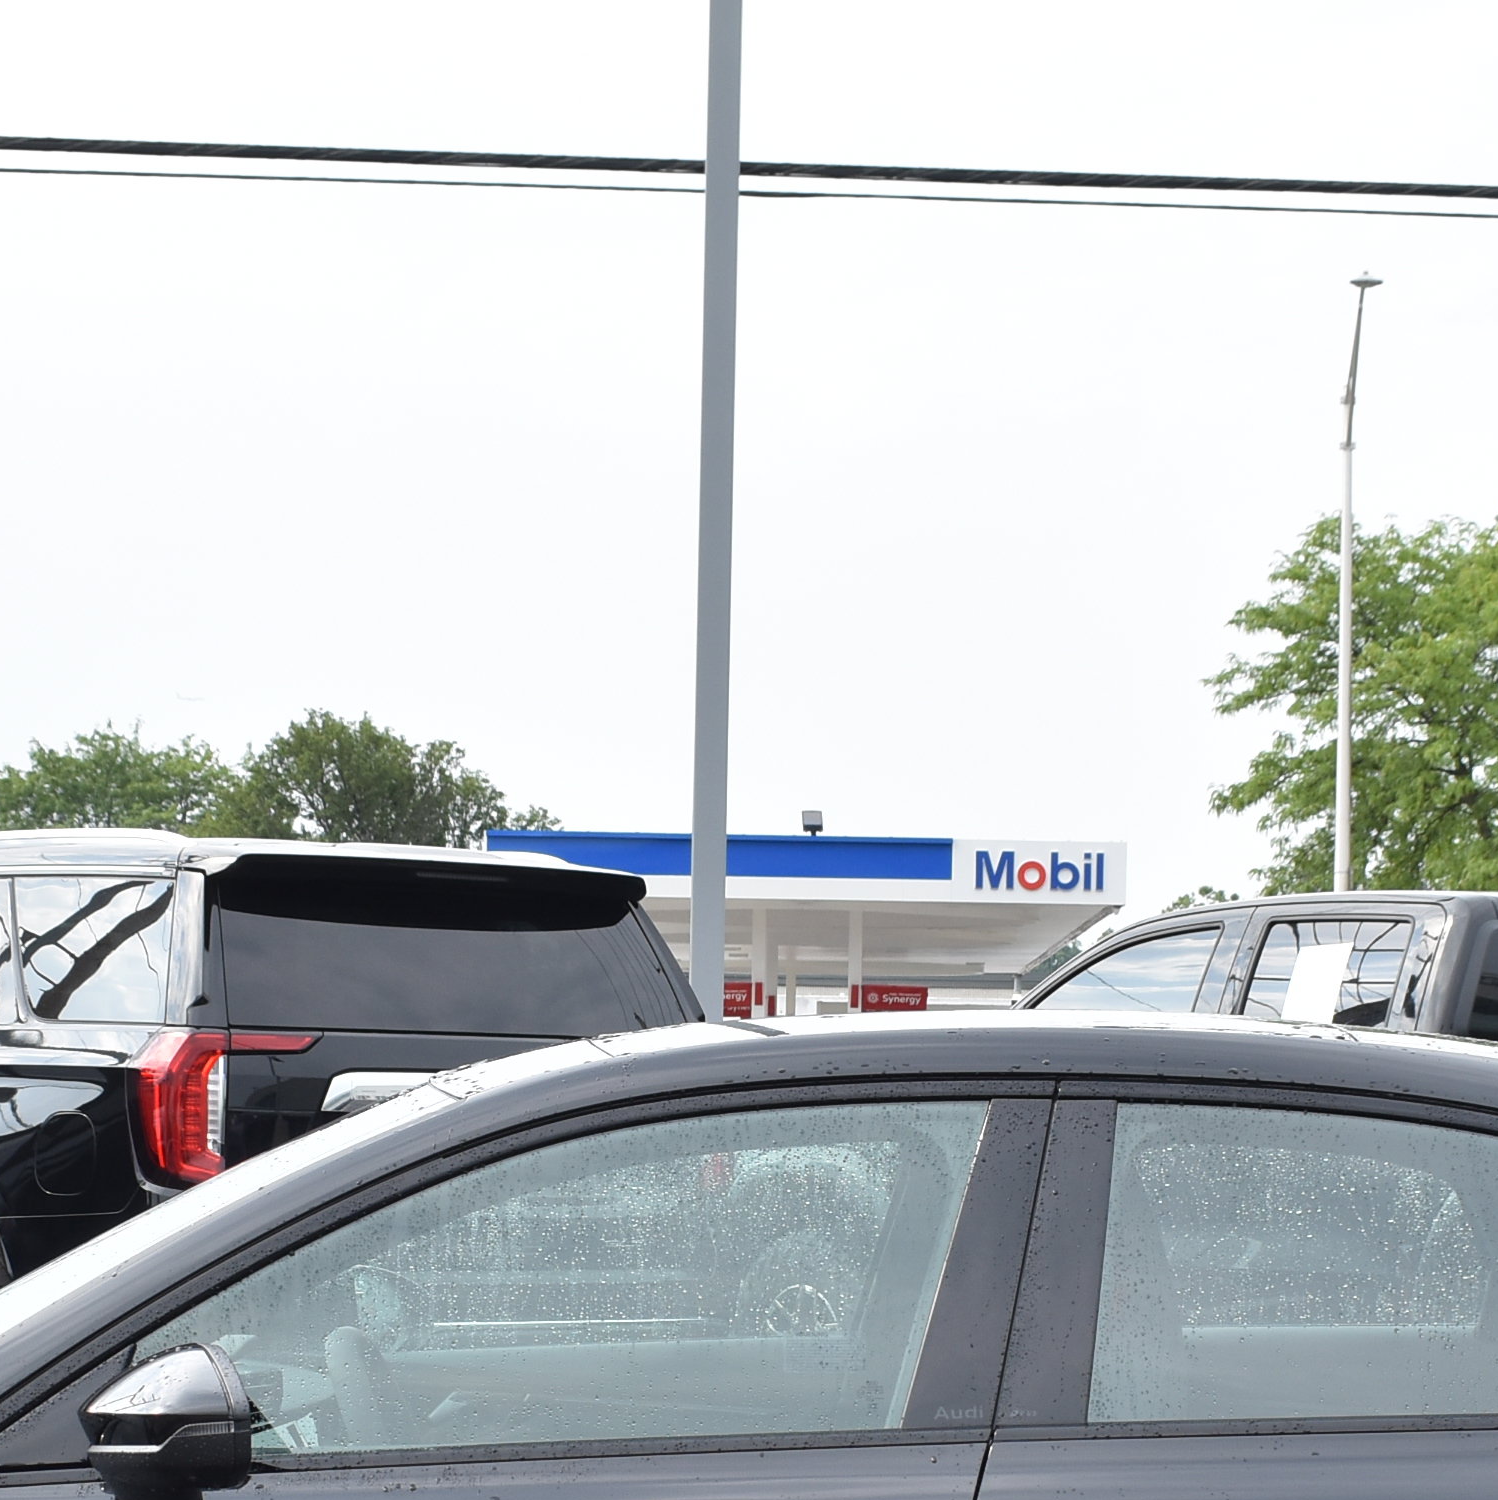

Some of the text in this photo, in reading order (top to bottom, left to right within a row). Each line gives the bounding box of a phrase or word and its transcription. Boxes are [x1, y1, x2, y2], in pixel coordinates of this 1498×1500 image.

[975, 850, 1105, 891] Mobil
[882, 993, 922, 1006] Synergy
[933, 1405, 984, 1421] Audi
